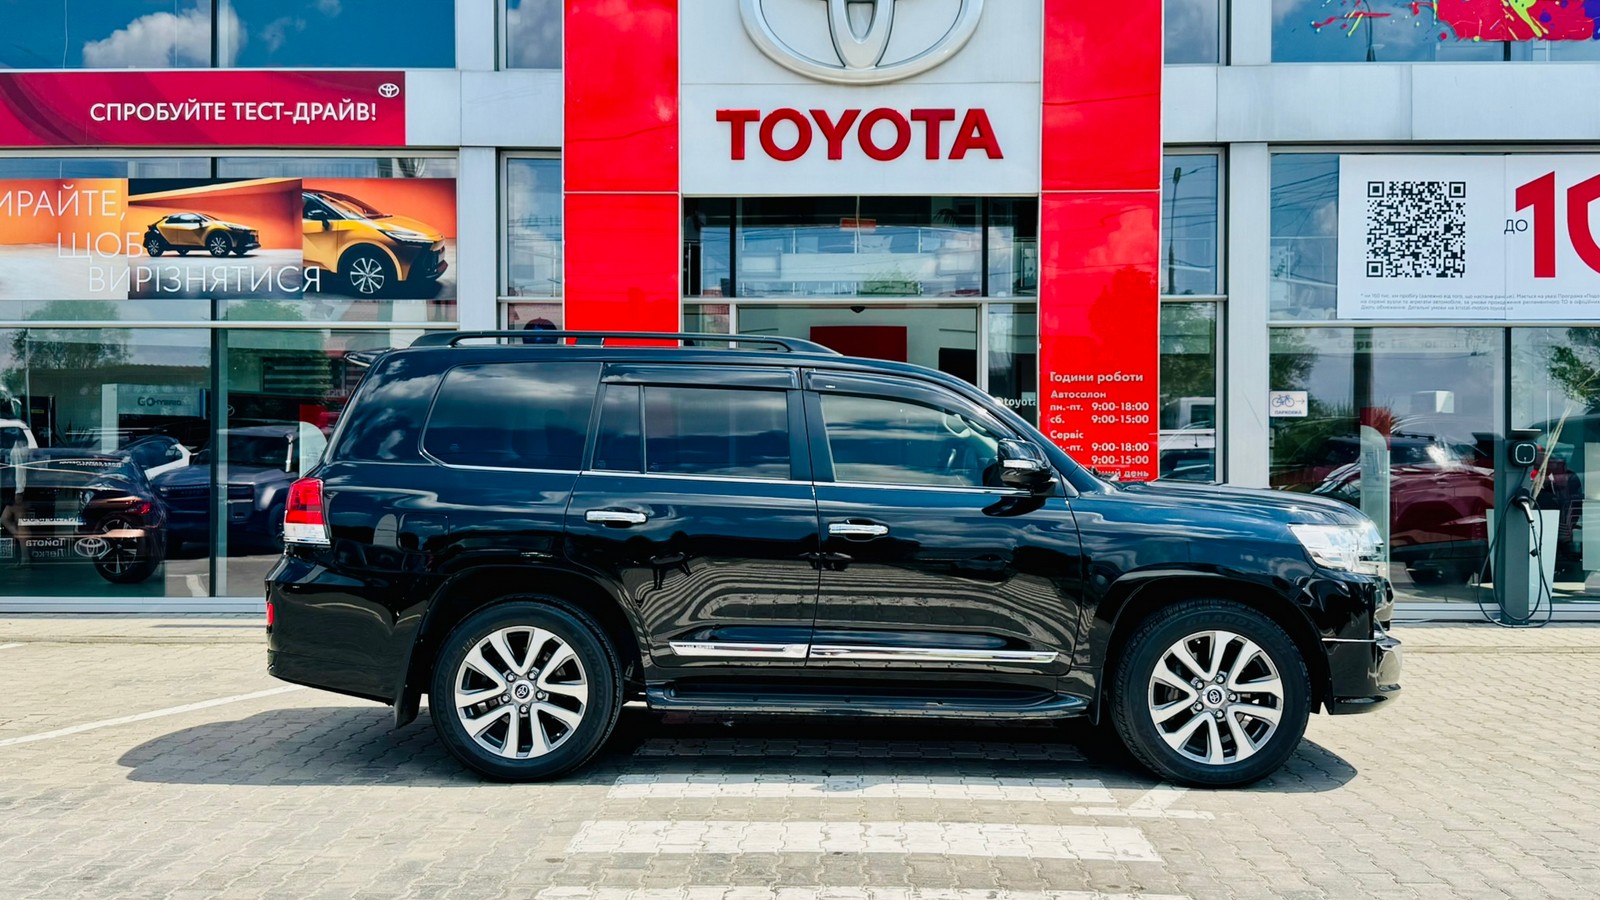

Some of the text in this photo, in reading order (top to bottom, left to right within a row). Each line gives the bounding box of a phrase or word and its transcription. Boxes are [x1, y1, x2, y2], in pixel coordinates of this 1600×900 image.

[90, 98, 377, 124] СПРОБУЙТЕ ТЕСТ-ДРАЙВ!
[715, 107, 1004, 162] TOYOTA
[58, 231, 144, 264] ЩОБ
[87, 265, 321, 293] ВИРІЗНЯТИСЯ
[1050, 371, 1144, 384] Години роботи
[1050, 390, 1107, 399] Автосалон
[1050, 415, 1065, 424] сб.
[1050, 430, 1084, 441] Сервіс
